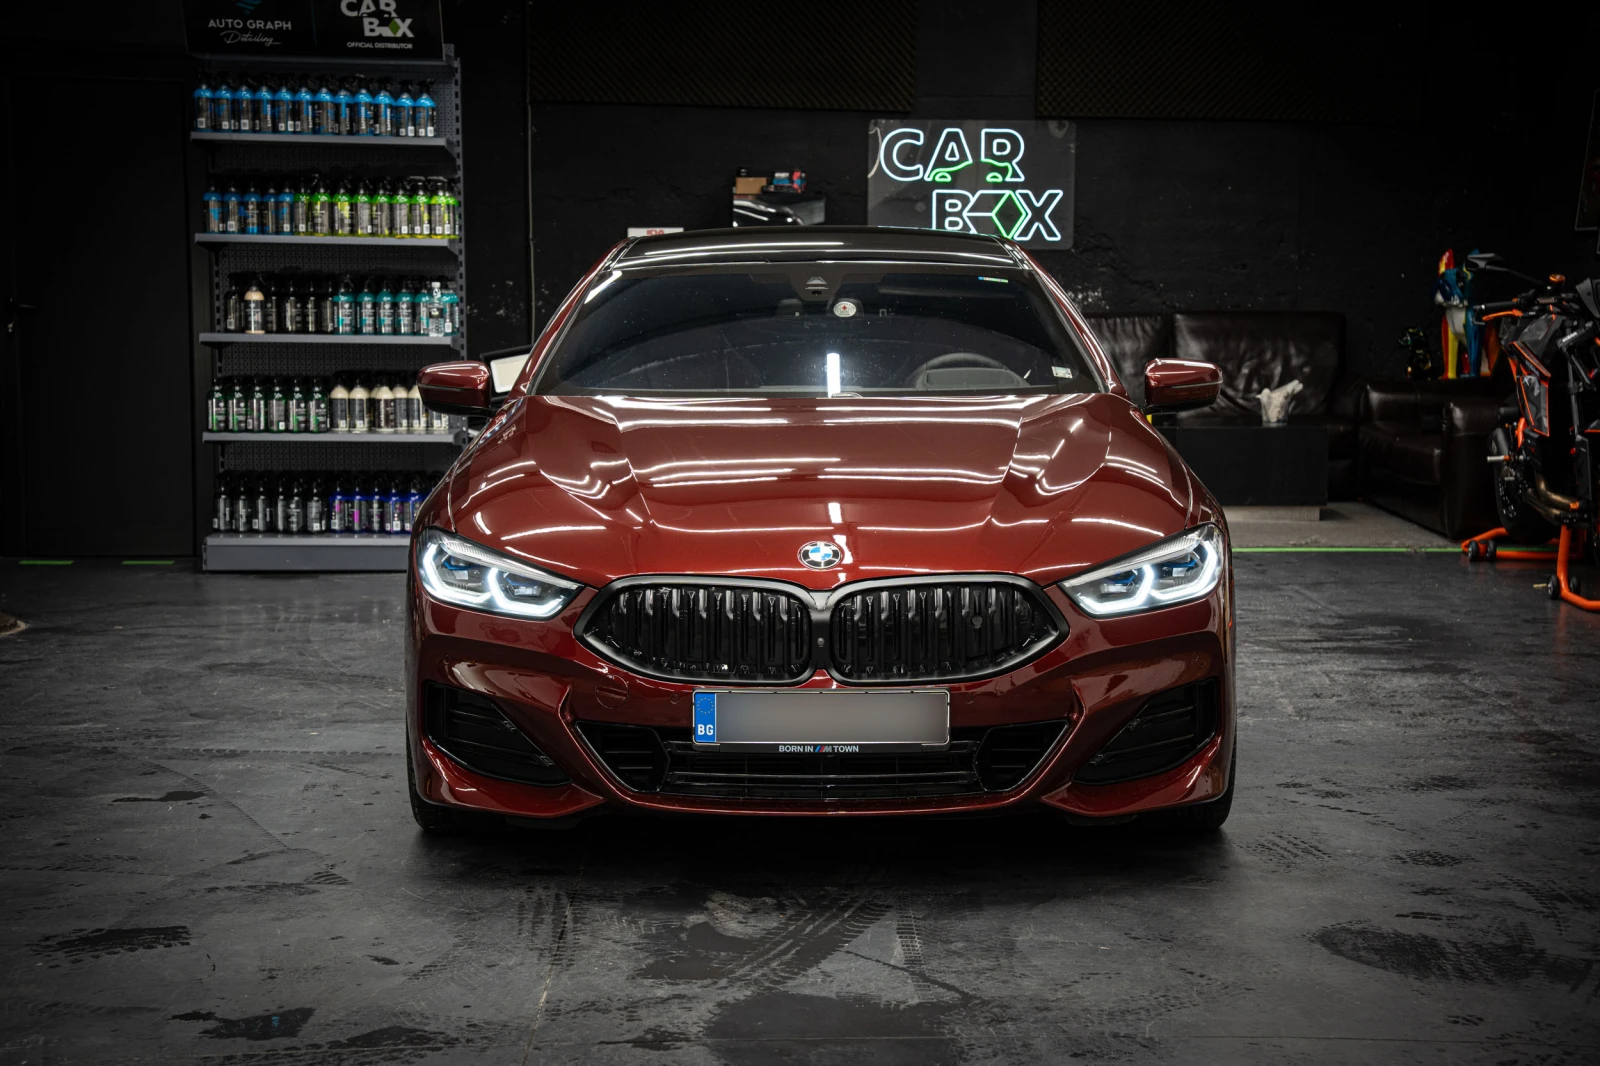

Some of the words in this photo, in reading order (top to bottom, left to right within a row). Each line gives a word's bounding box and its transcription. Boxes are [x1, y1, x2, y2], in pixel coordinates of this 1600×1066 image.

[340, 0, 398, 17] CAR
[208, 18, 244, 29] AUTO
[246, 19, 292, 31] GRAPH
[219, 30, 283, 47] Detailing
[374, 42, 413, 50] DISTRIBUTOR
[879, 127, 1025, 182] CAR
[932, 189, 1064, 241] BOX
[697, 724, 714, 736] BG
[778, 745, 804, 753] BORN
[804, 745, 814, 753] IN
[833, 745, 859, 753] TOWN
